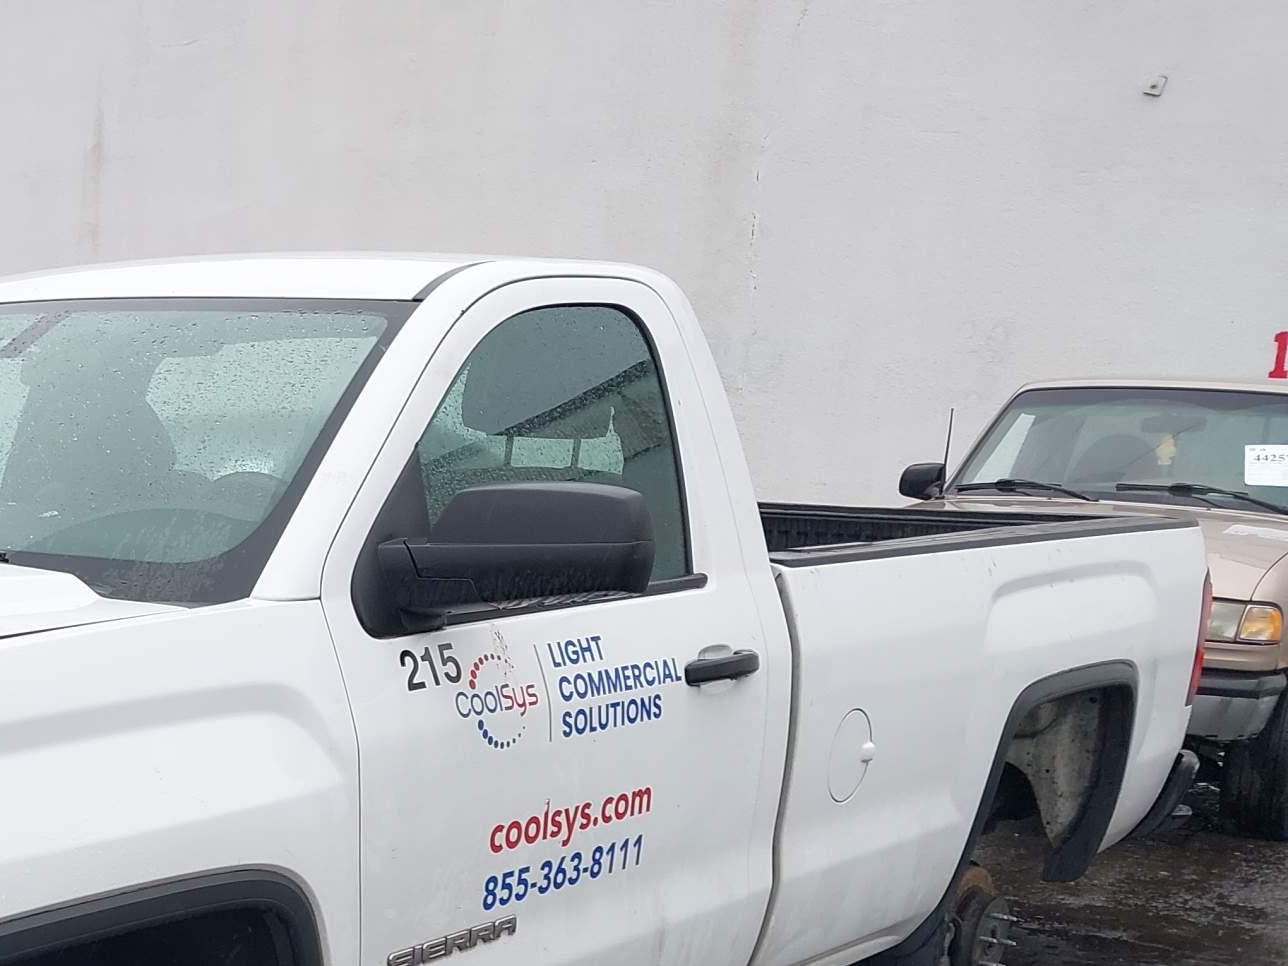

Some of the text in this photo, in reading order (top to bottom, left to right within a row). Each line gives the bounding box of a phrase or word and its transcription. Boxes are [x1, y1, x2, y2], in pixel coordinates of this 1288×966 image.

[399, 642, 463, 692] 215
[547, 635, 604, 668] LIGHT
[455, 683, 539, 719] CoolSys
[558, 657, 682, 703] COMMERCIAL
[562, 693, 662, 738] SOLUTIONS
[489, 786, 653, 853] coolsys.com
[482, 833, 643, 911] 855-363-8111
